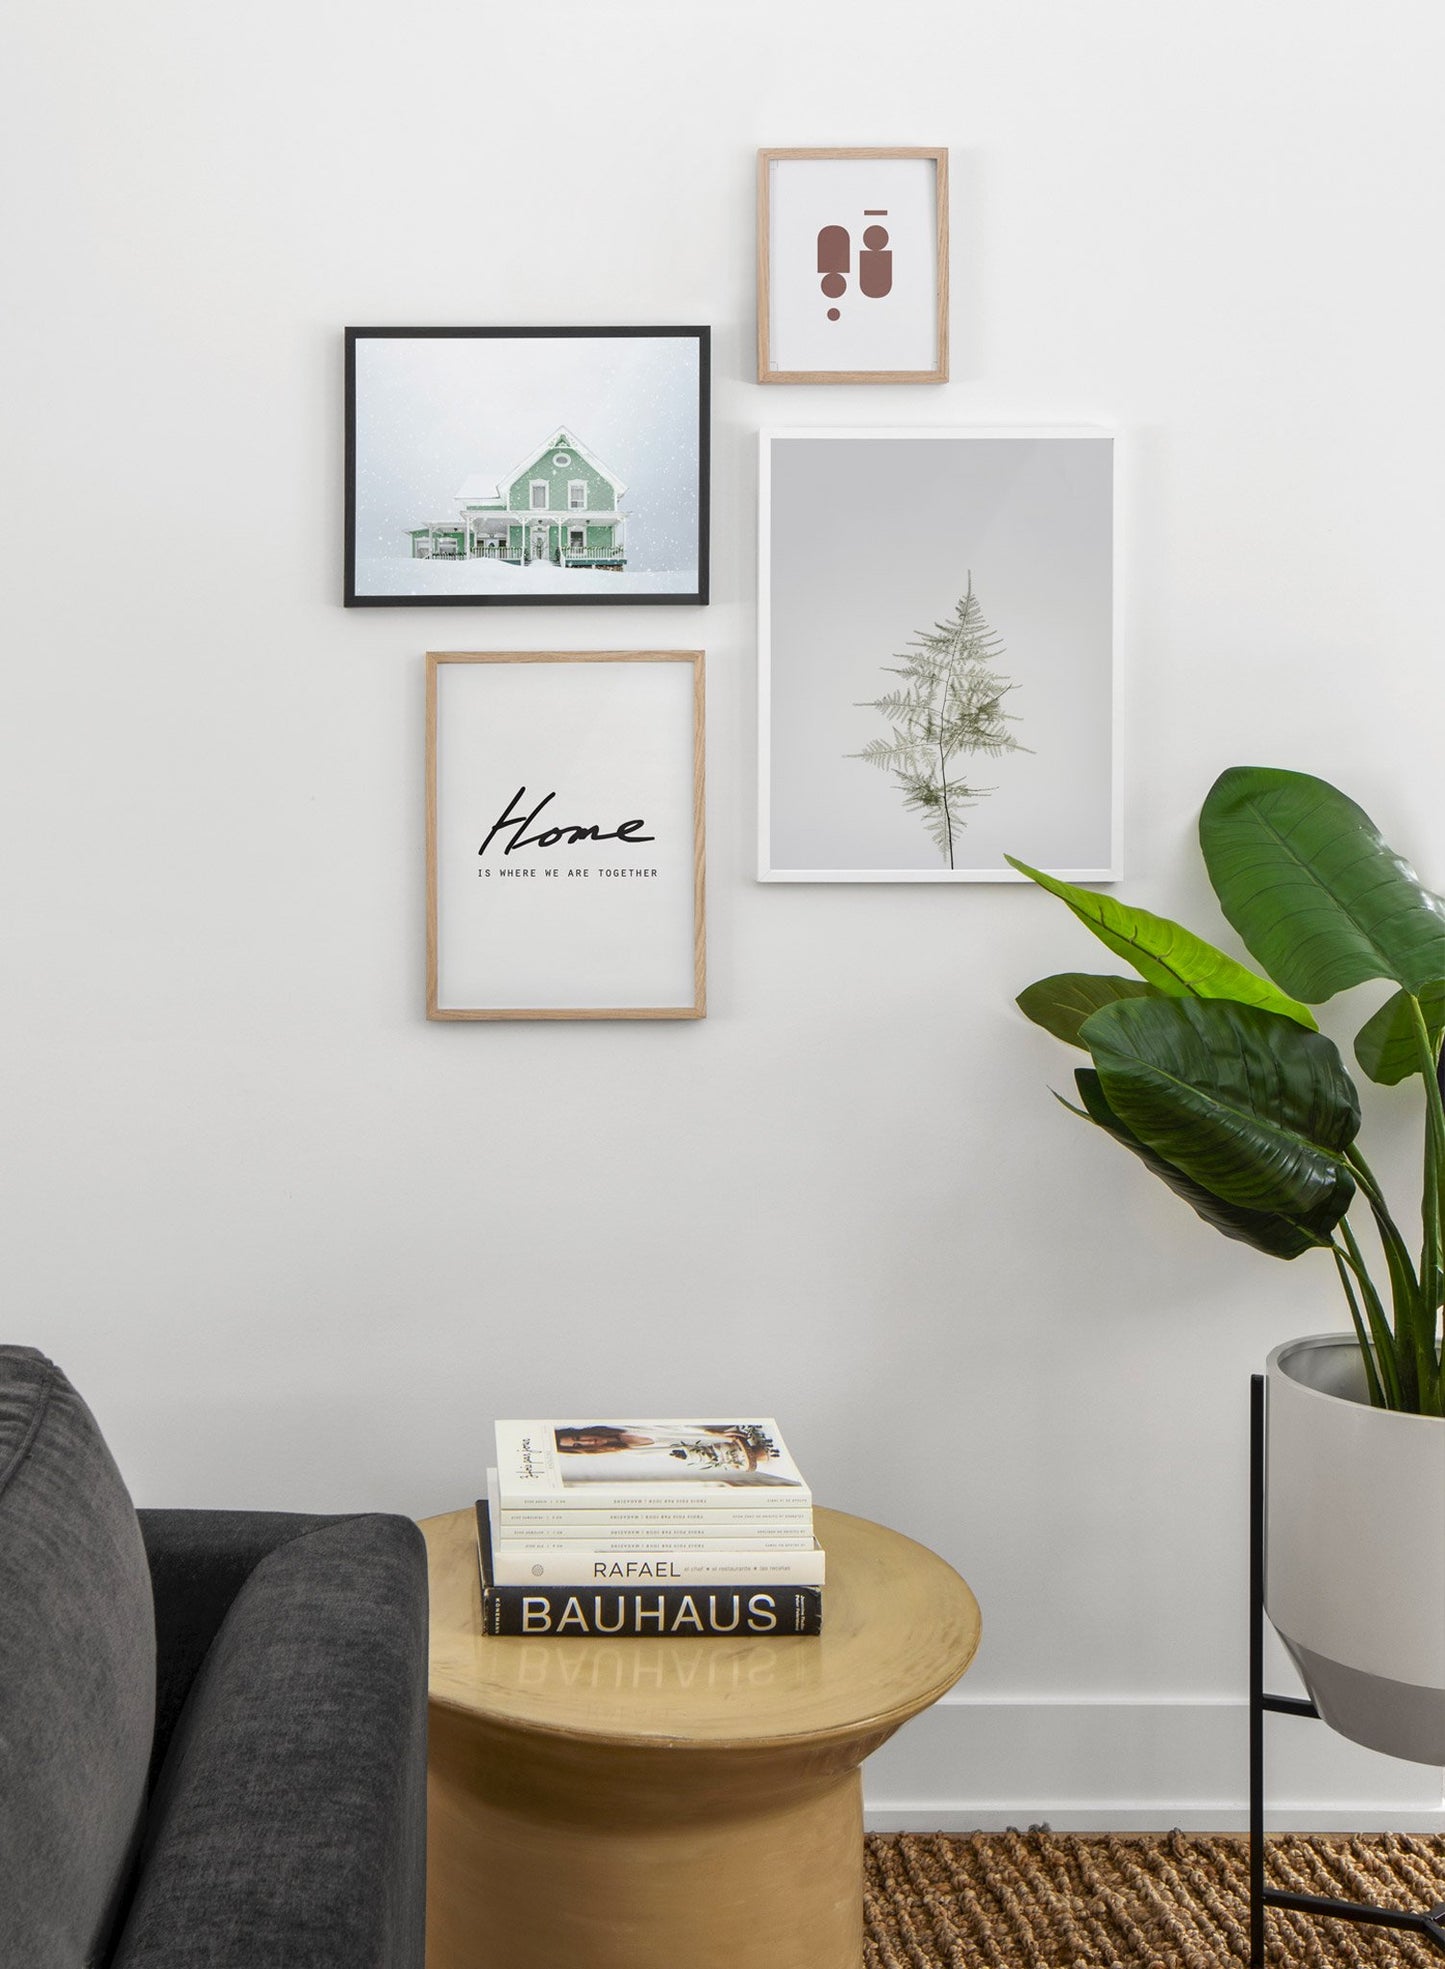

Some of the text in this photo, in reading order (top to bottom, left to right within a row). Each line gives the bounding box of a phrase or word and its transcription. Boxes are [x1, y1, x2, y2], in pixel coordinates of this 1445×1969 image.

[478, 786, 655, 856] Home
[478, 869, 657, 878] IS WHERE WE ARE TOGETHER
[593, 1562, 681, 1578] RAFAEL
[522, 1594, 777, 1633] BAUHAUS
